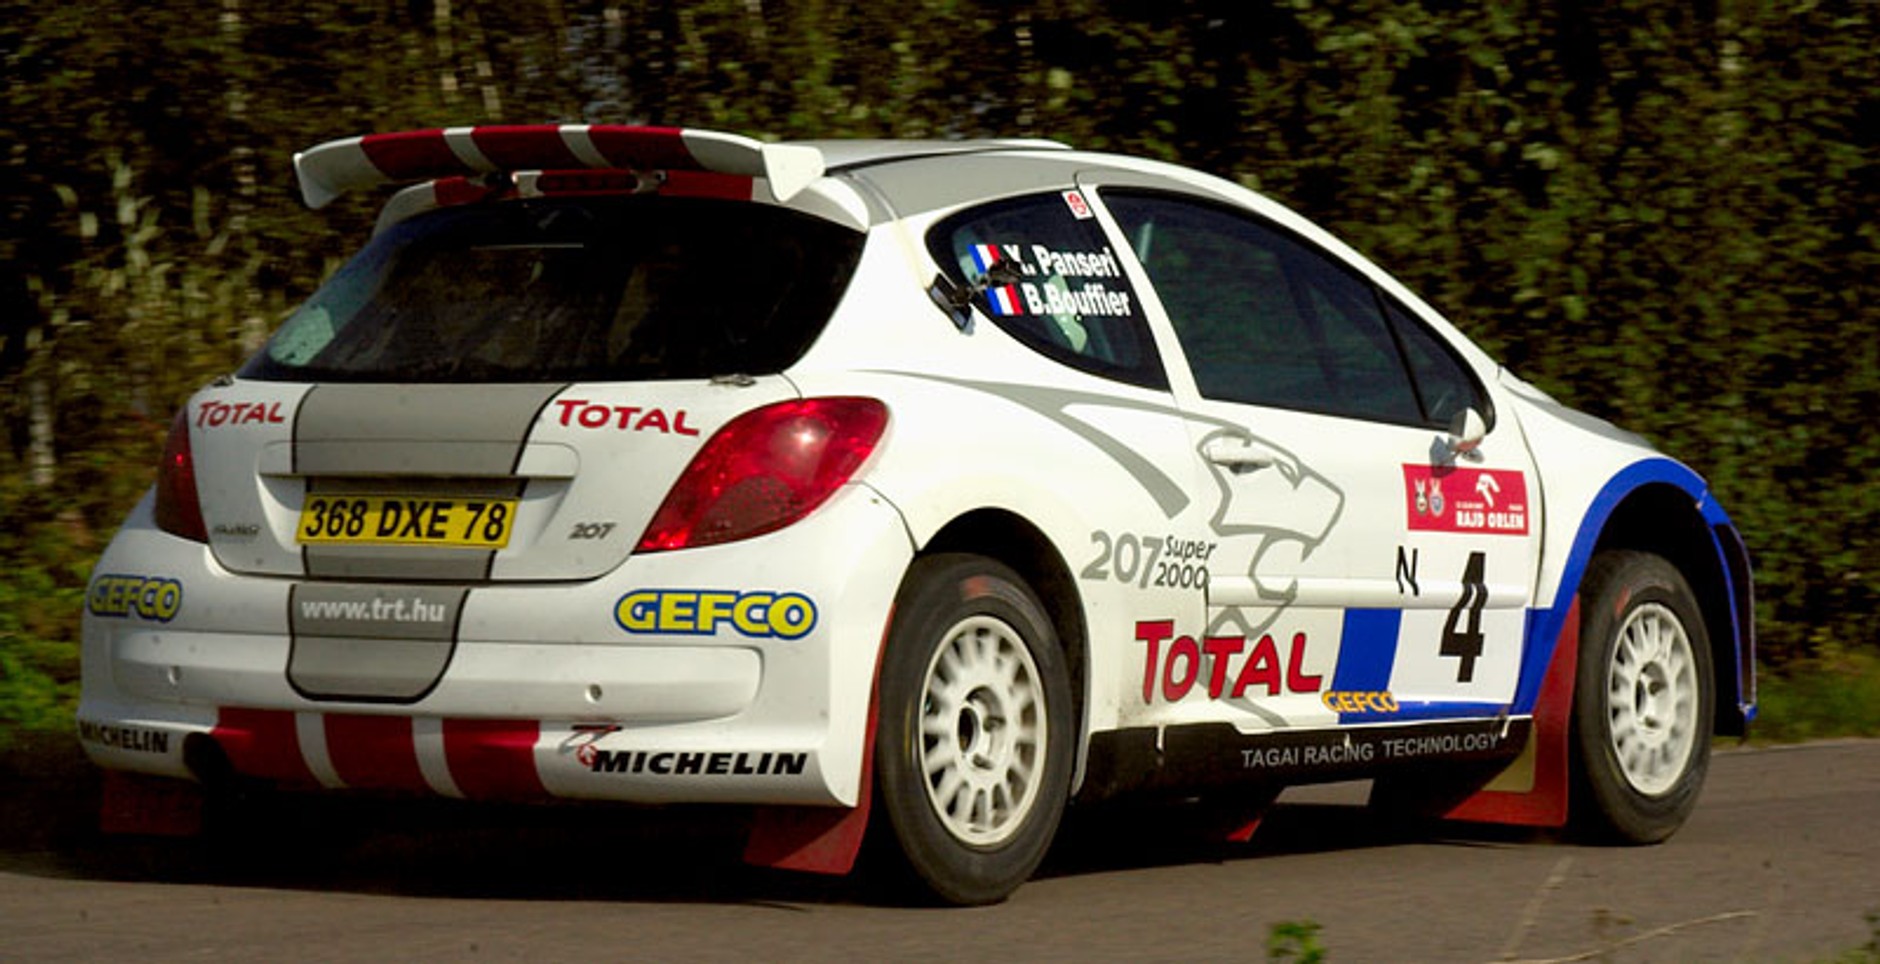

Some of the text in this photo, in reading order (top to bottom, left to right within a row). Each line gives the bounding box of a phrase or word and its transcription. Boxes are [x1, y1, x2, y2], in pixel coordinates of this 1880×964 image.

[1031, 245, 1120, 277] Panseri
[1021, 283, 1132, 317] B.Bouffier
[197, 400, 286, 427] TOTAL
[555, 399, 700, 436] TOTAL
[306, 500, 508, 541] 368 DXE 78
[569, 522, 615, 541] 207
[1456, 511, 1484, 527] RAJD
[1080, 529, 1217, 589] 207 Super
[1154, 561, 1210, 590] 2000
[1396, 545, 1419, 597] N
[90, 576, 182, 621] GEFCO
[302, 598, 446, 622] www.trt.hu
[615, 589, 818, 639] GEFCO
[1439, 551, 1489, 683] 4
[1135, 619, 1323, 705] TOTAL
[1321, 690, 1399, 713] GEFCO
[80, 720, 168, 754] MICHELIN
[1242, 733, 1501, 768] TAGAI RACING TECHNOLOGY
[592, 750, 808, 775] MICHELIN
